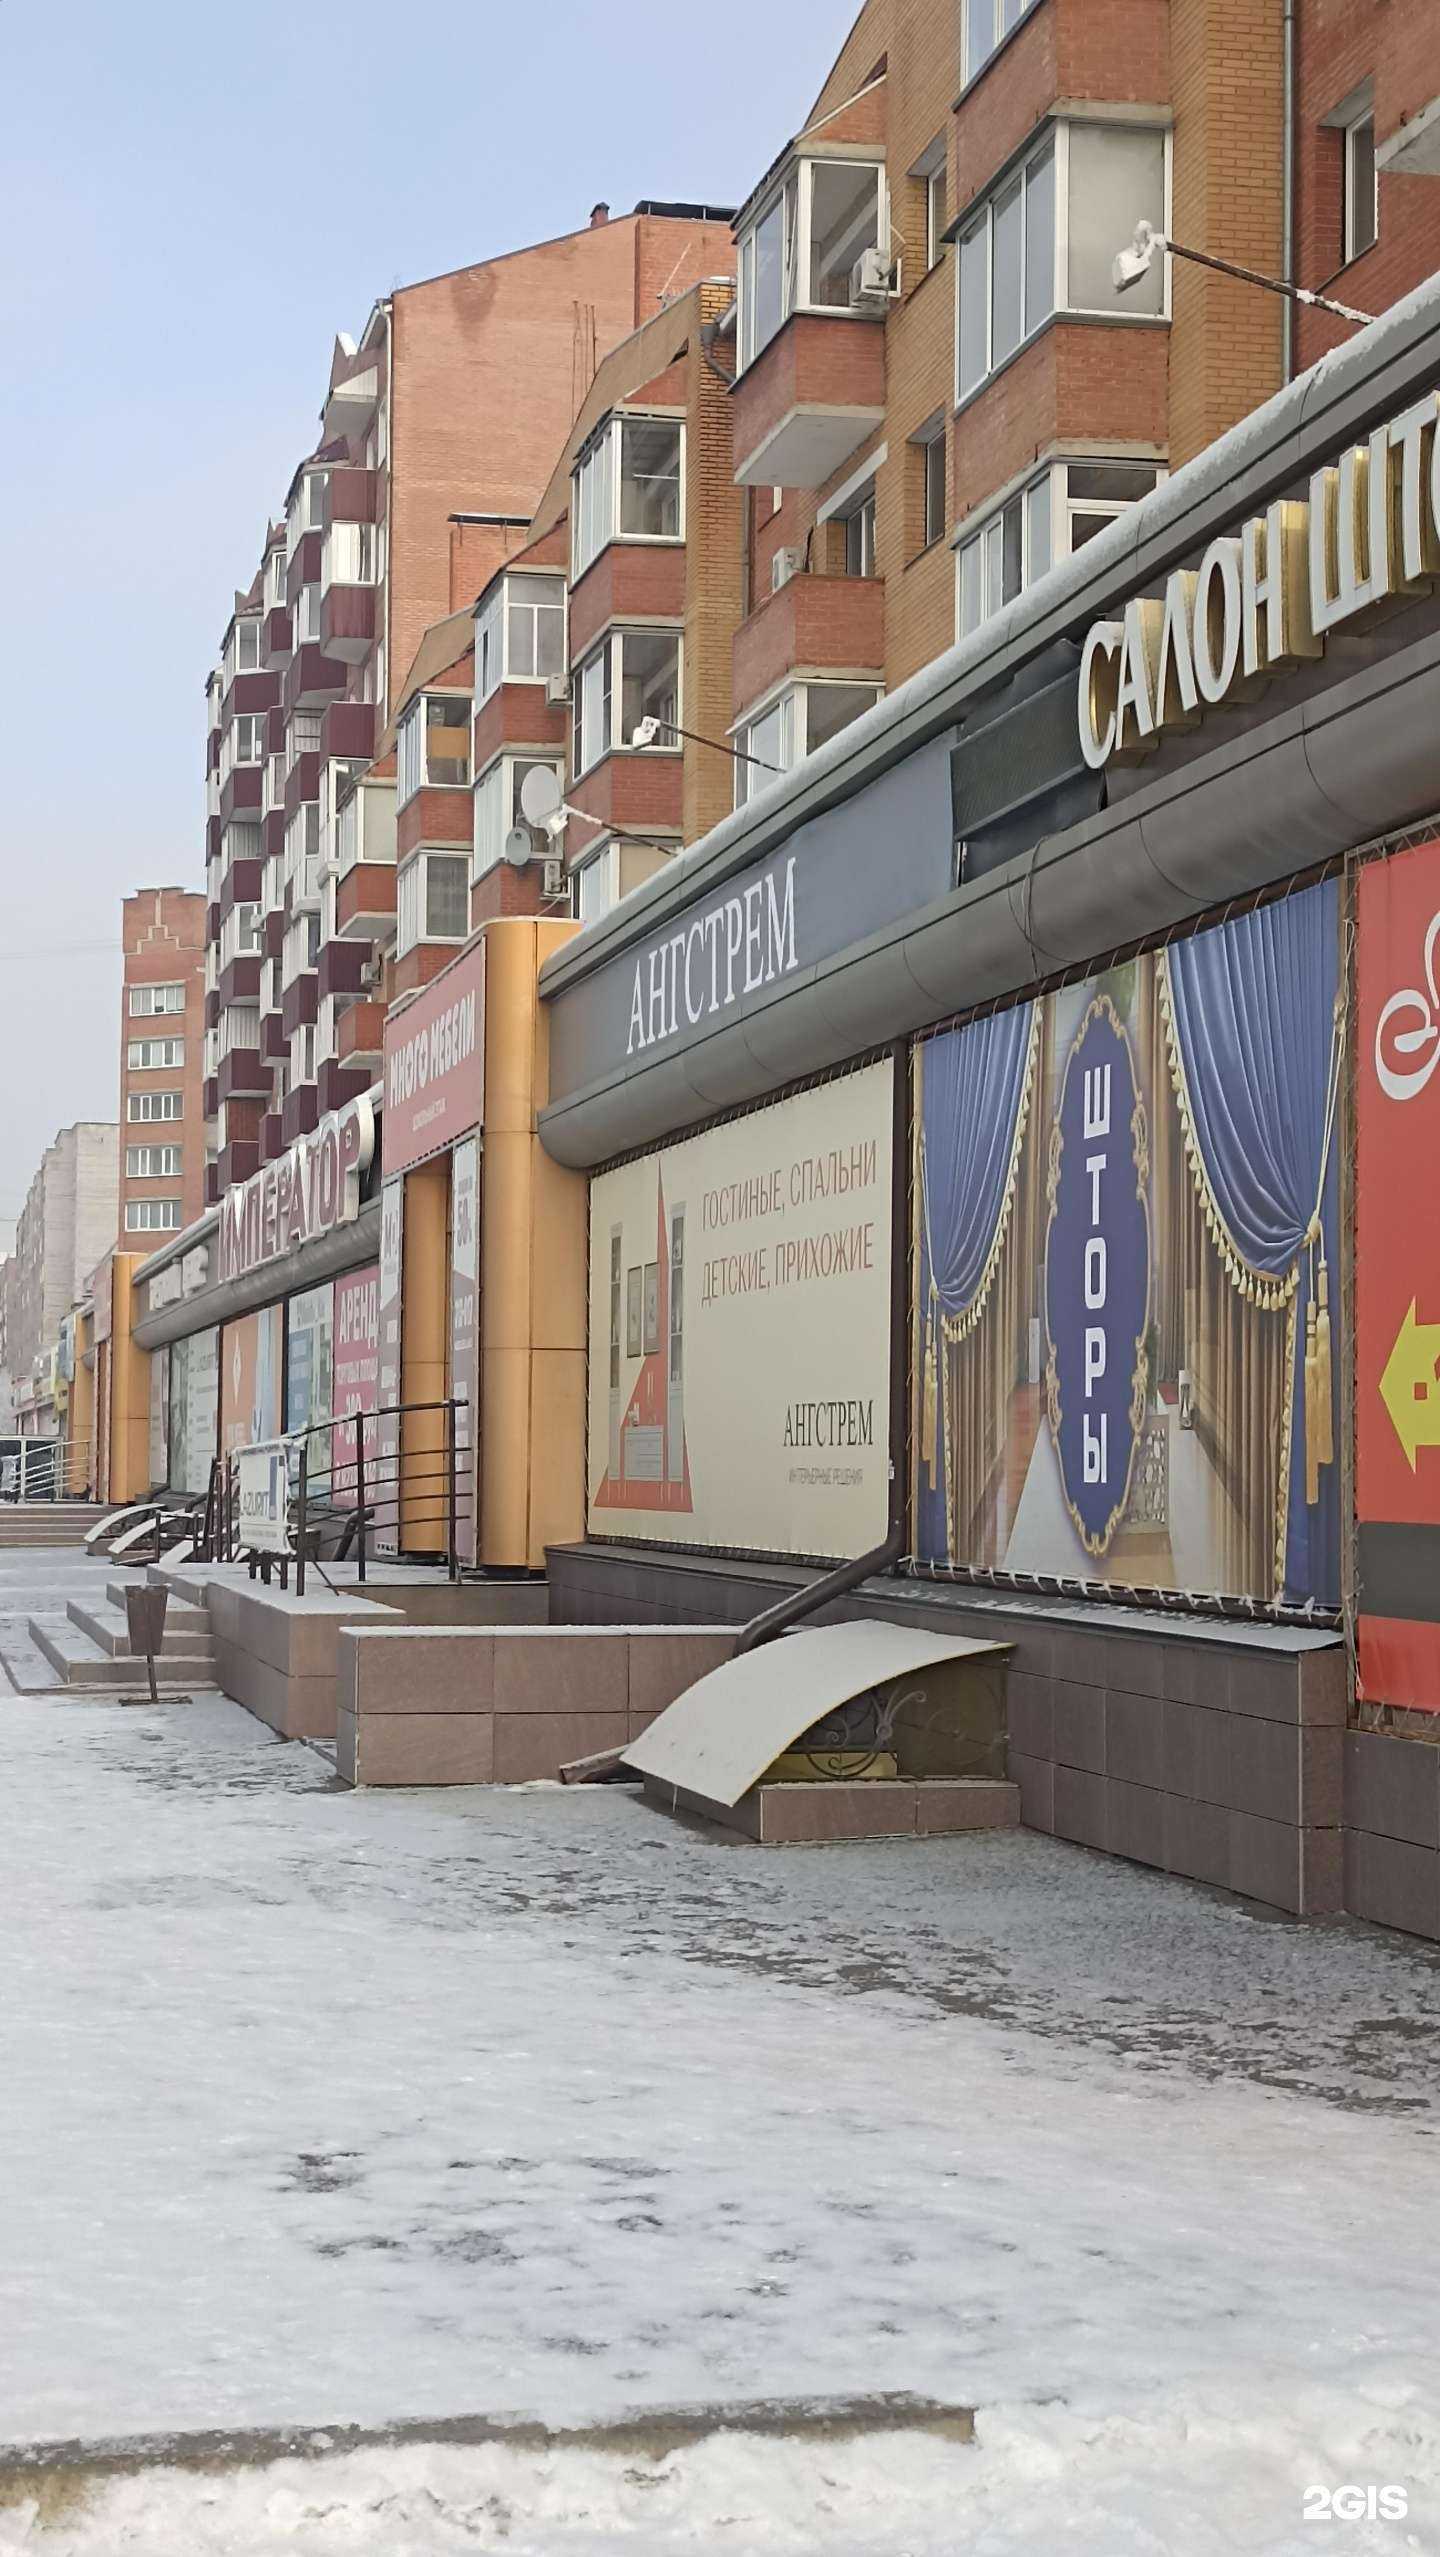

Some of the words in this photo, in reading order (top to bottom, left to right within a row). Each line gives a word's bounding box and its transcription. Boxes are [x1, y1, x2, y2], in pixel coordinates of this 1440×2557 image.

[1078, 499, 1292, 770] САЛОН
[1309, 390, 1440, 636] ШТ
[627, 856, 799, 1055] АНГСТРЕМ
[390, 1028, 428, 1110] МНОГО
[430, 989, 476, 1082] МЕБЕЛИ
[217, 1098, 375, 1285] ИМПЕРАТОР
[702, 1169, 785, 1231] ГОСТИНЫЕ,
[790, 1139, 877, 1206] СПАЛЬНИ
[340, 1281, 379, 1349] АРЕНД
[701, 1247, 771, 1308] ДЕТСКИЕ,
[775, 1222, 875, 1286] ПРИХОЖИЕ
[1082, 1063, 1112, 1484] ШТОРЫ
[782, 1399, 874, 1447] АНГСТРЕМ
